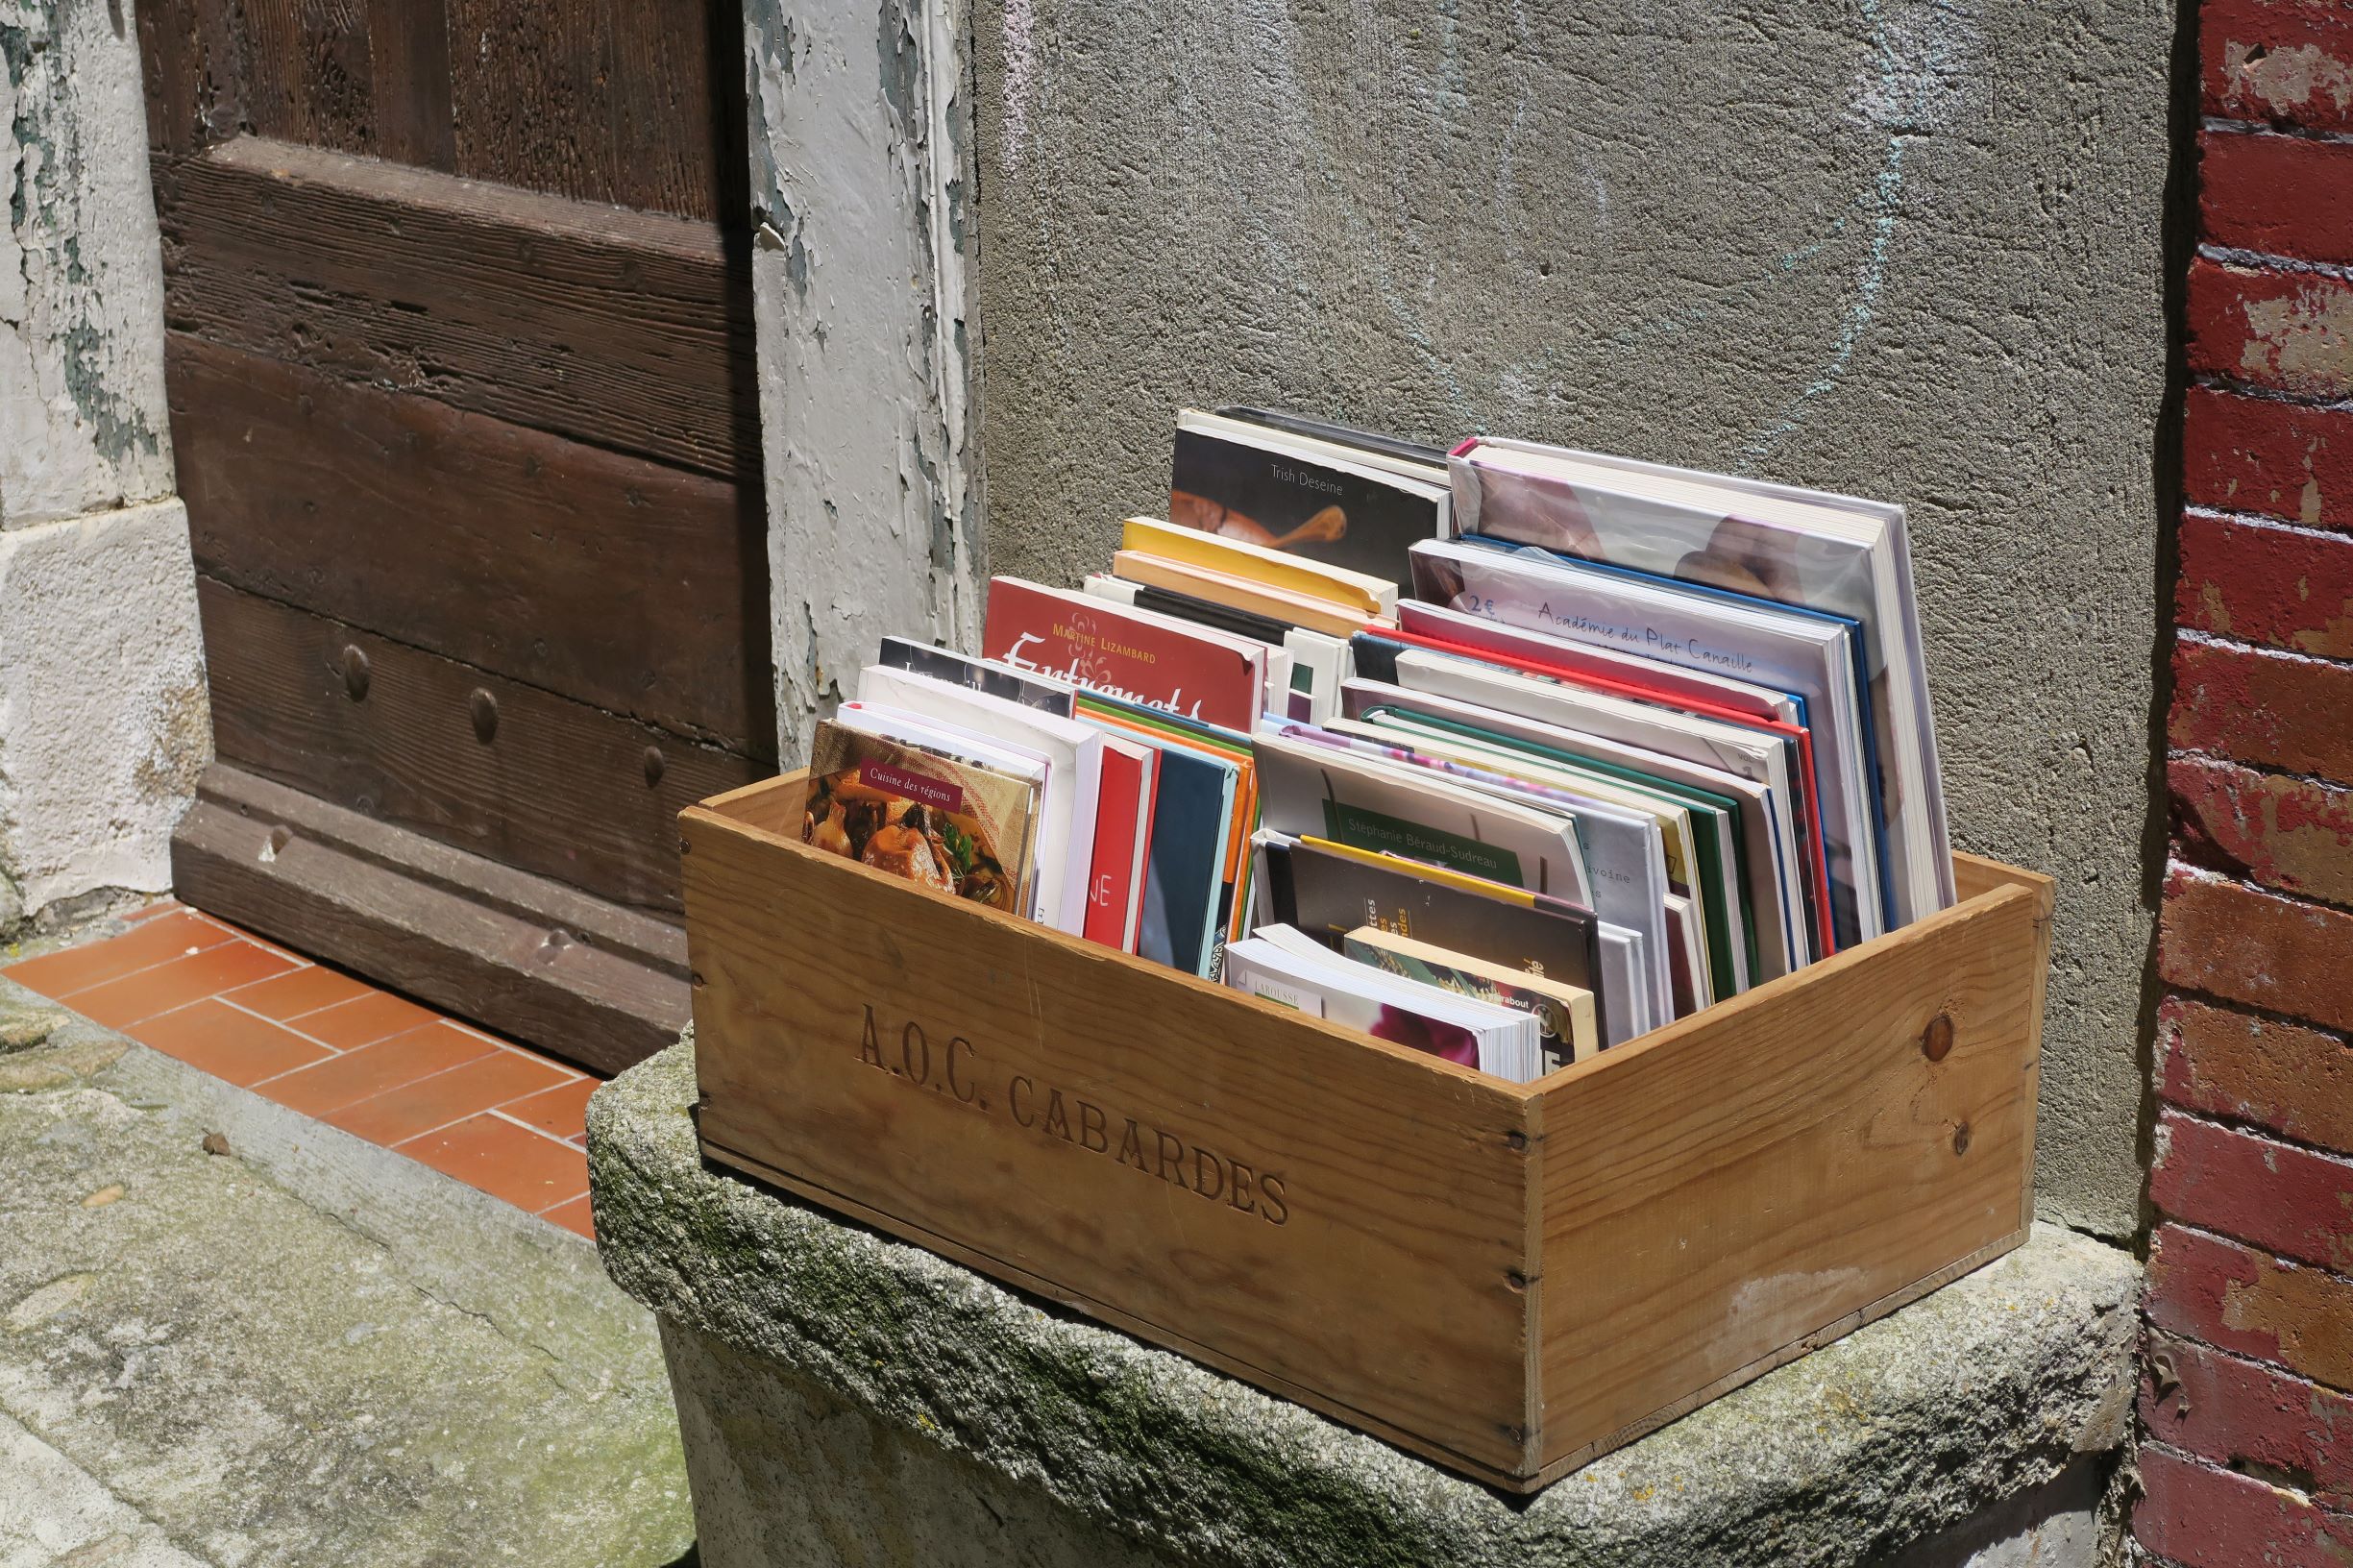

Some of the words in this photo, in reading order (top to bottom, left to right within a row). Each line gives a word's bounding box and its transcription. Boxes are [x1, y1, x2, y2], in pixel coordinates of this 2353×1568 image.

[1270, 463, 1295, 483] Trish
[1299, 471, 1343, 496] Deseine
[1538, 601, 1614, 639] Académie
[1621, 627, 1639, 643] du
[1646, 627, 1682, 654] Plat
[1688, 639, 1753, 674] Canaille
[870, 767, 901, 787] Cuisine
[904, 778, 918, 792] des
[920, 786, 950, 802] régions
[1348, 818, 1403, 844] Stéphanie
[1406, 833, 1498, 870] Béraud-Sudreau
[1255, 979, 1299, 1006] LAROUSSE
[860, 1003, 990, 1111] A.O.C.
[1009, 1075, 1288, 1227] CABARDES
